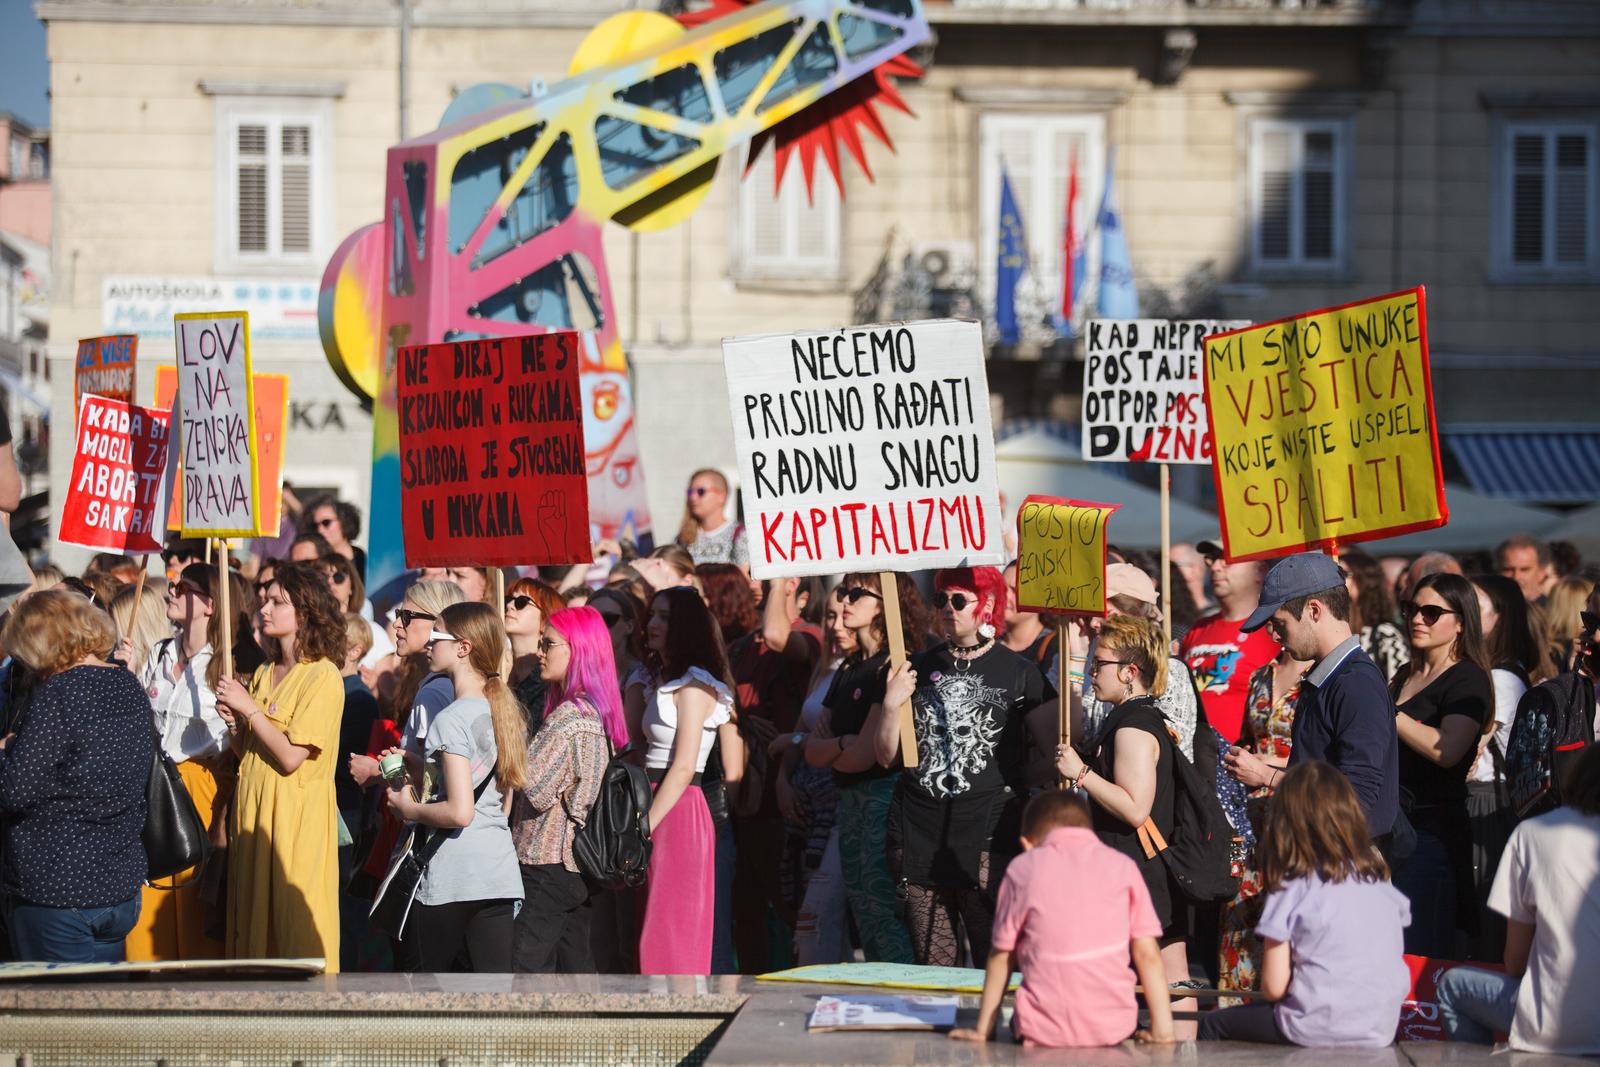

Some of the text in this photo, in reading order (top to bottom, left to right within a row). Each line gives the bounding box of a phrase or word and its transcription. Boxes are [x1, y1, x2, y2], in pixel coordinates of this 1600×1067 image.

[108, 284, 224, 299] AUTOŠKOLA
[181, 323, 239, 366] LOV
[404, 335, 568, 386] NE DIRAJ ME S
[792, 328, 915, 383] NEĆEMO
[1089, 322, 1138, 351] KAD
[1210, 302, 1420, 380] MI SMO UNUKE
[195, 368, 231, 410] NA
[1089, 351, 1198, 386] POSTAJE
[1226, 349, 1413, 427] VJEŠTICA
[87, 404, 142, 436] KADA
[150, 416, 167, 439] BI
[402, 388, 484, 435] KRUNICOM
[744, 377, 974, 439] PRISILNO RAĐATI
[1086, 390, 1208, 425] OTPOR POS
[81, 430, 134, 464] MOGLI
[183, 409, 250, 470] ŽENSKA
[404, 434, 584, 489] SLOBODA JE STVORENA
[1223, 434, 1276, 476] KOJE
[1350, 403, 1428, 448] USPJELI
[752, 434, 979, 499] RADNU SNAGU
[185, 473, 249, 523] PRAVA
[422, 491, 524, 541] U MUKAMA
[1243, 455, 1406, 537] SPALITI
[760, 495, 986, 564] KAPITALIZMU
